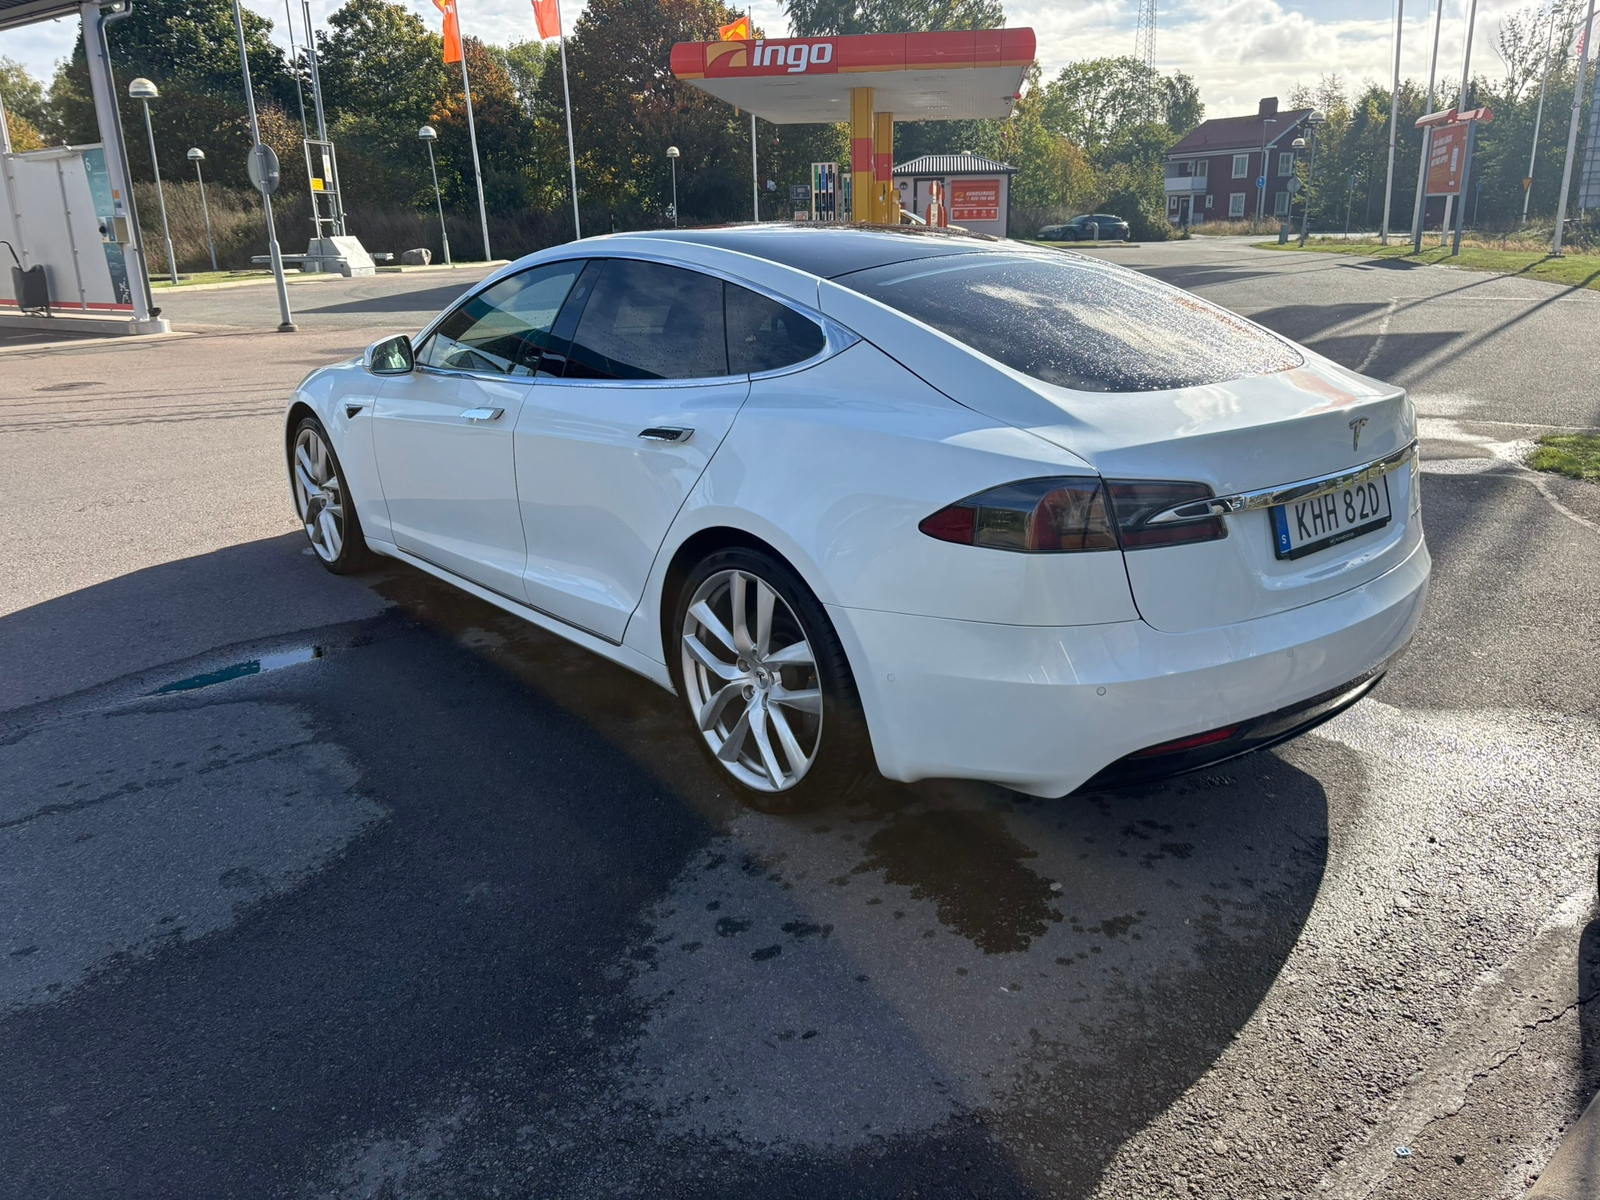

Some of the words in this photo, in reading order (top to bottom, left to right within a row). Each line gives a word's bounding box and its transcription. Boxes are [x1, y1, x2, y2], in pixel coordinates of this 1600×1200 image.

[753, 40, 832, 72] ingo
[85, 157, 92, 171] 6
[1295, 495, 1340, 541] KHH
[1345, 482, 1380, 524] 82D
[1281, 534, 1288, 544] S
